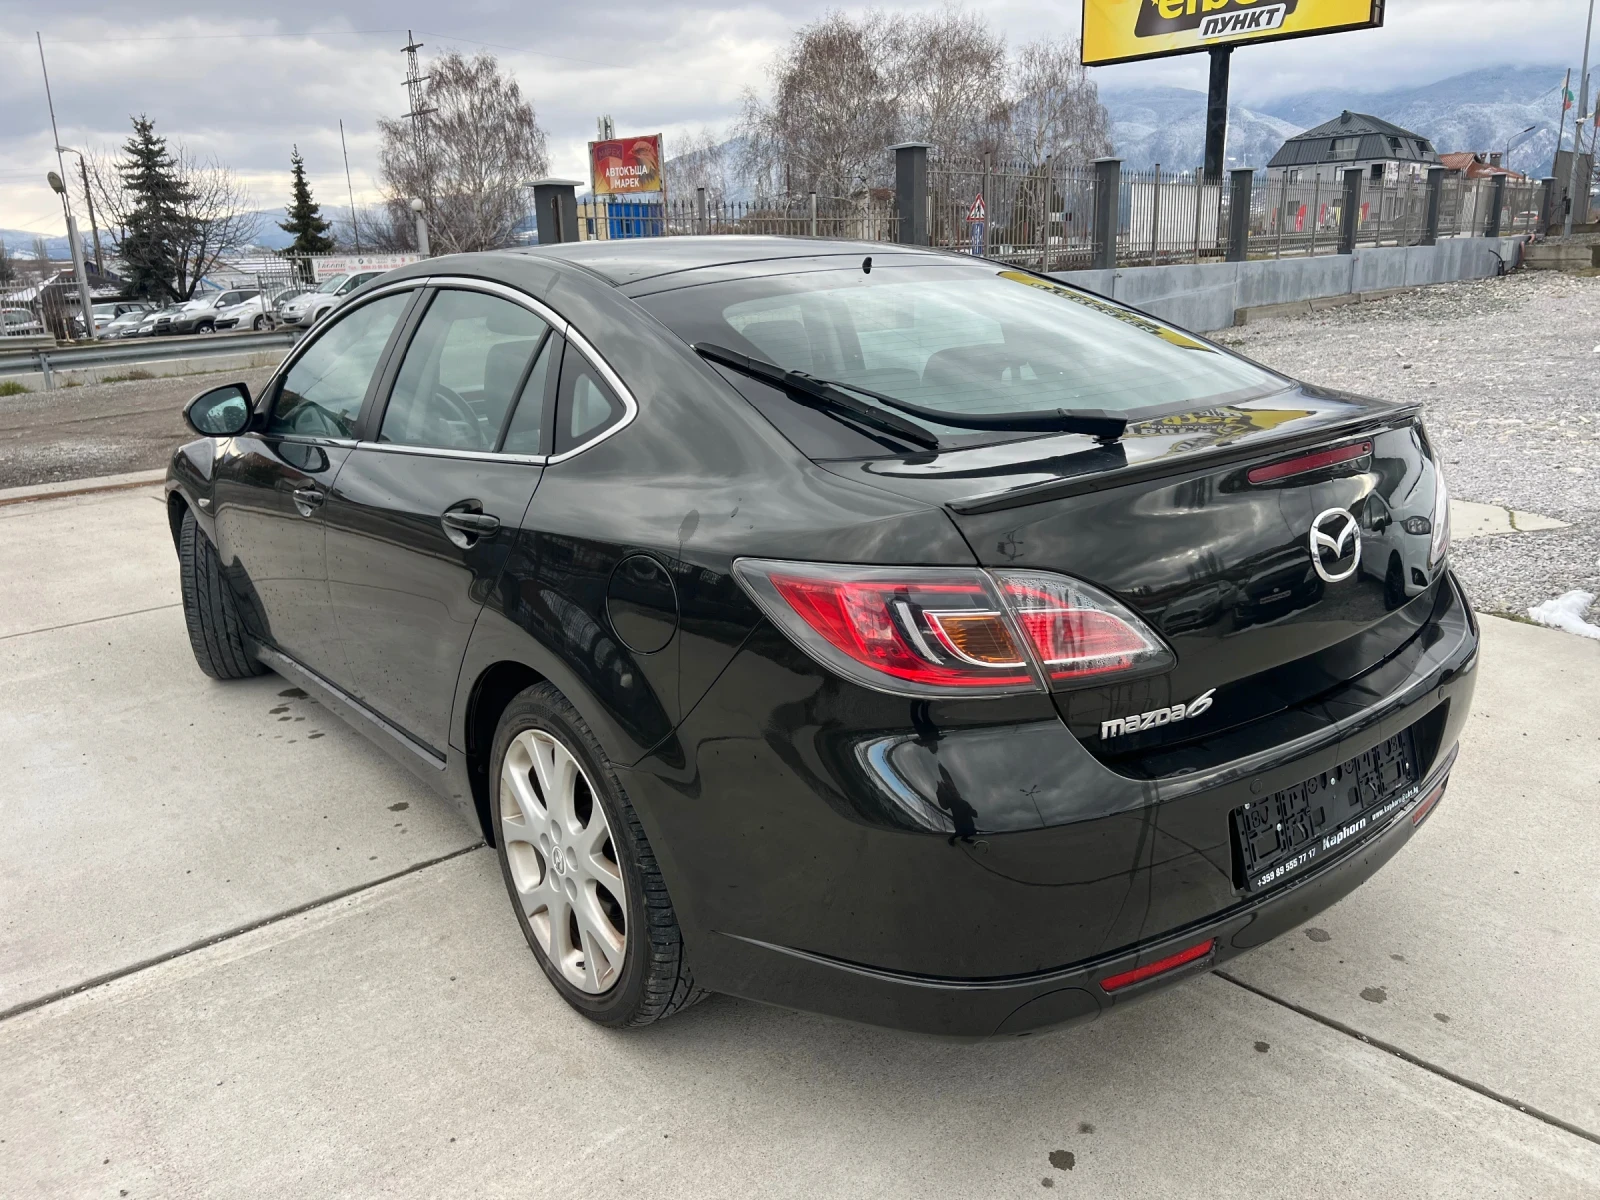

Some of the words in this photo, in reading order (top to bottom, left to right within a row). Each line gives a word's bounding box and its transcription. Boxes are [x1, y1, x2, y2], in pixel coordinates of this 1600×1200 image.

[1202, 7, 1280, 36] ПУНКТ
[605, 165, 648, 177] АВТОКЪЩА
[614, 178, 640, 189] МАРЕК
[1257, 871, 1275, 887] +359
[1275, 865, 1285, 877] 89
[1285, 858, 1298, 872] 555
[1298, 852, 1307, 864] 77
[1308, 847, 1316, 859] 17
[1322, 817, 1366, 851] Kaphorn
